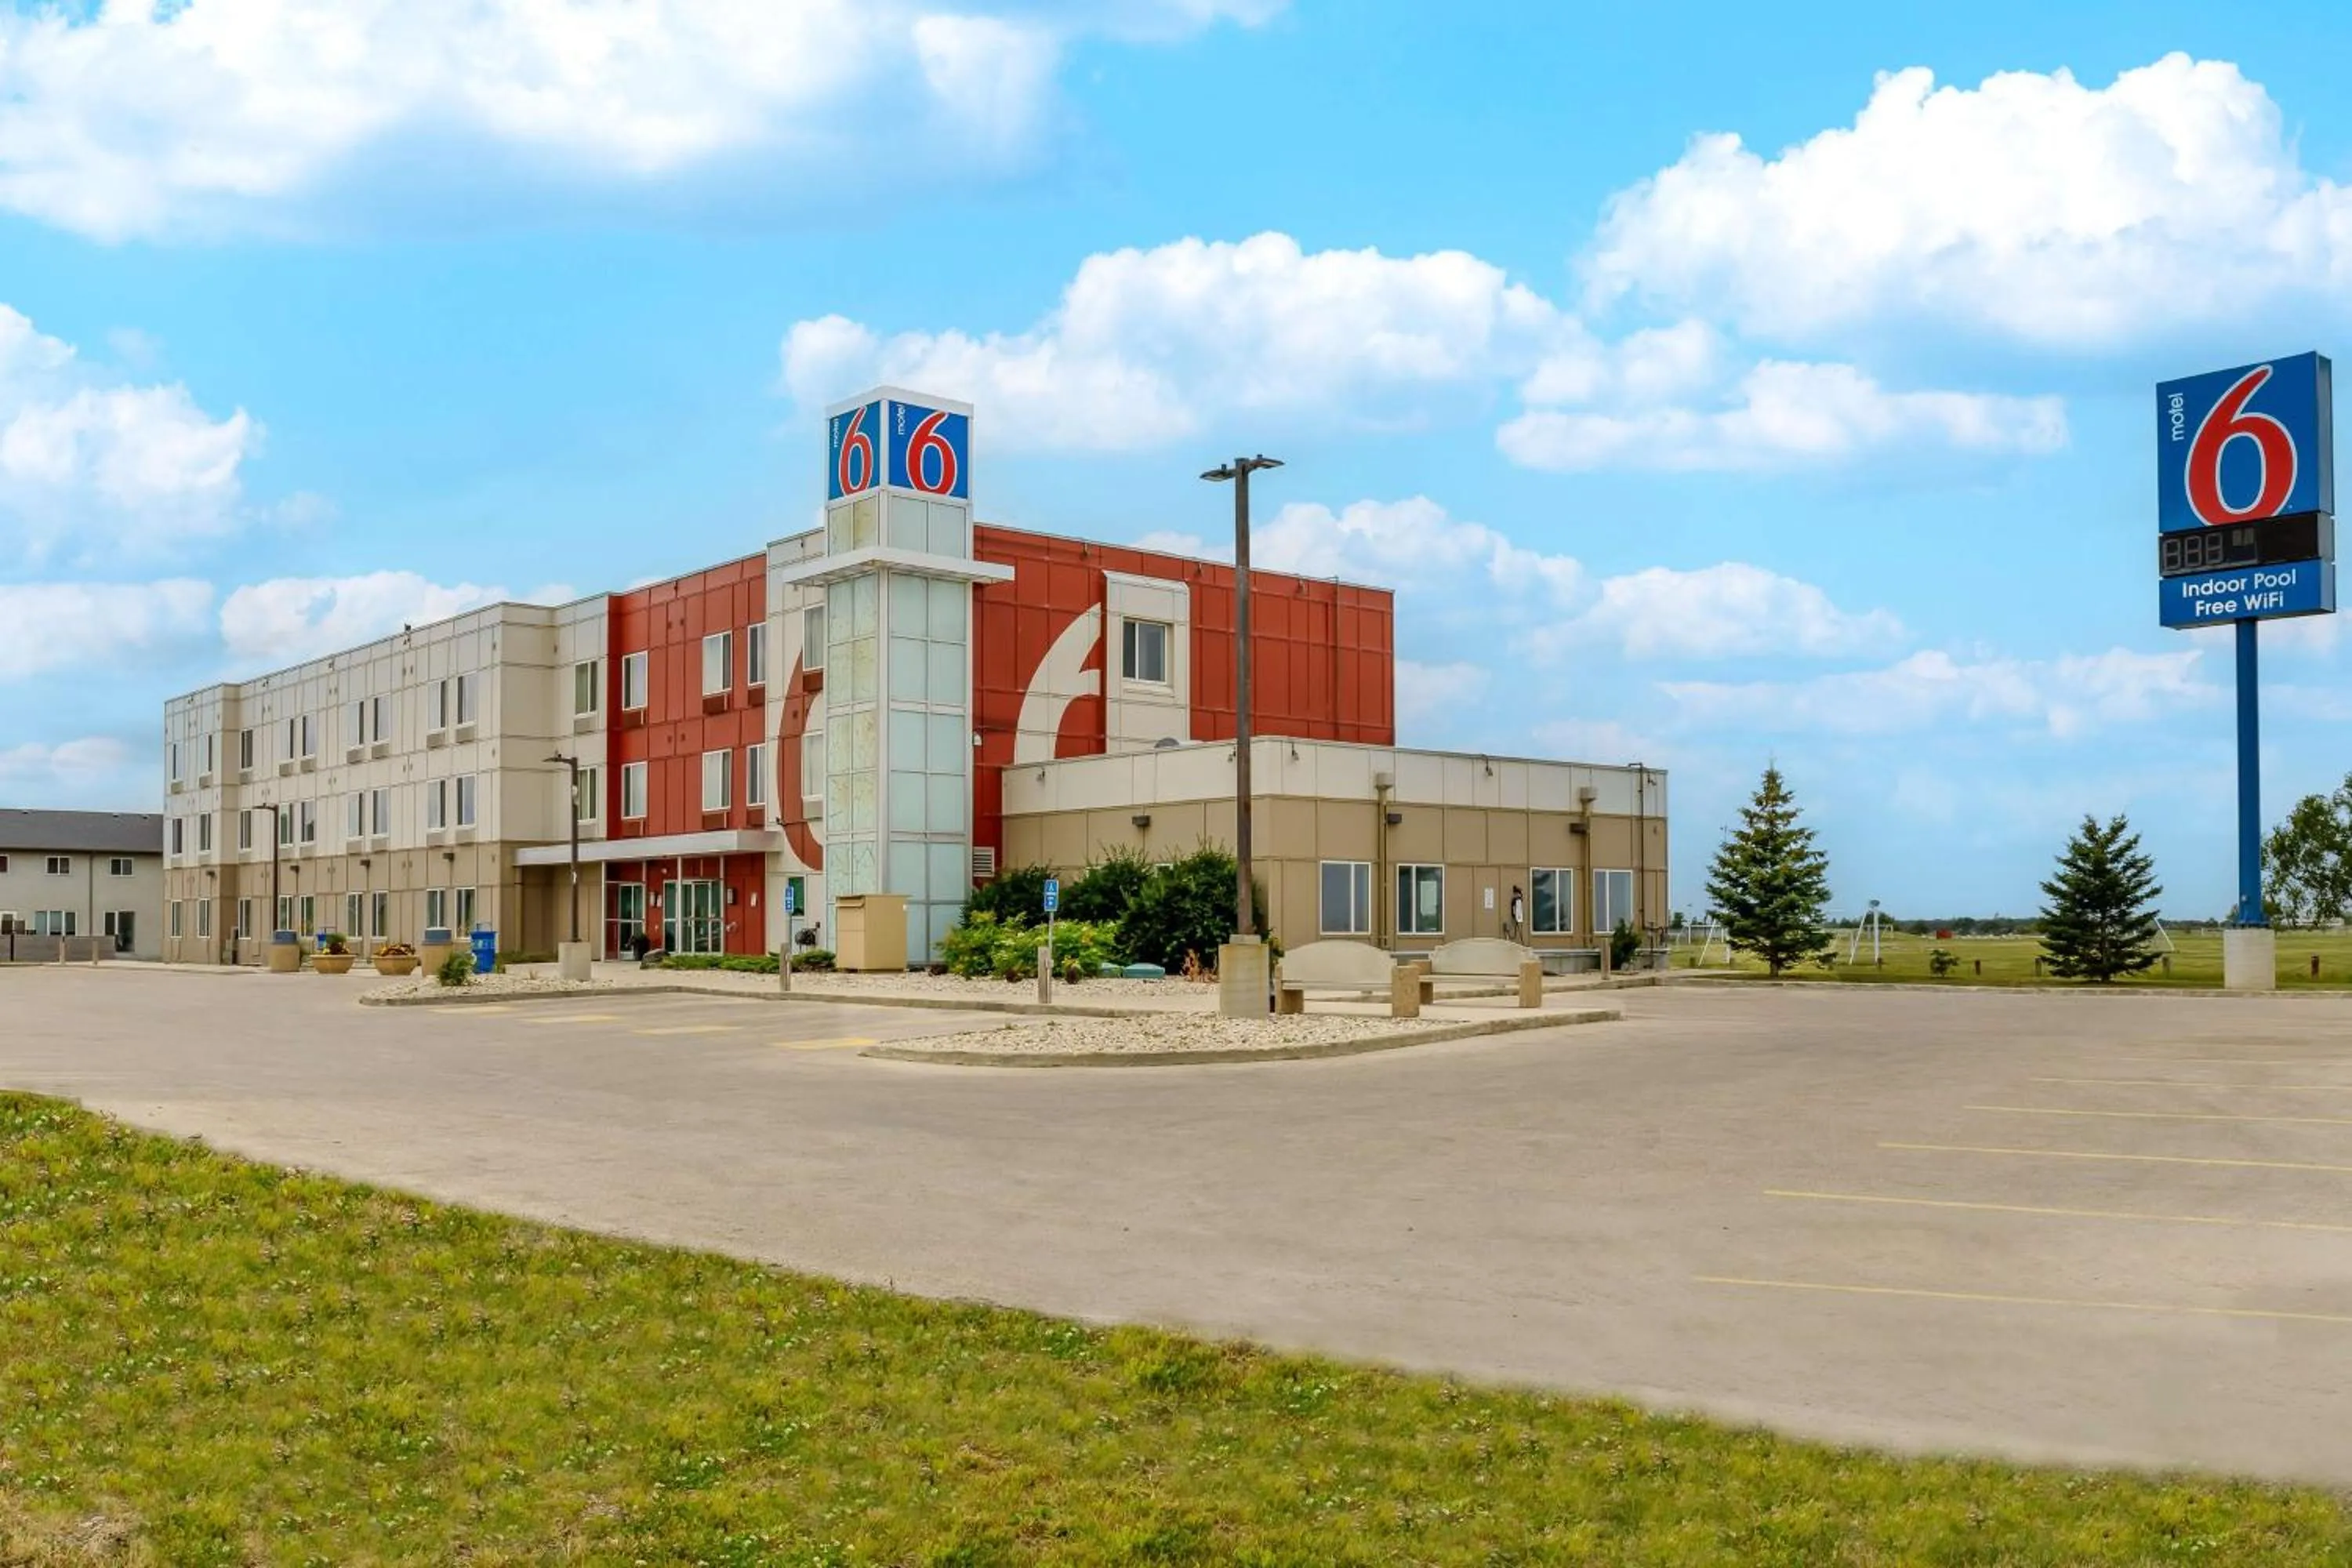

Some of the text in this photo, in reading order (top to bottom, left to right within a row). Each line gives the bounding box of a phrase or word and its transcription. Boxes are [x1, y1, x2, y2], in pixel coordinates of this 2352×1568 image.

[838, 405, 873, 495] 6
[896, 404, 957, 495] motel 6
[2167, 364, 2298, 526] motel 6
[2182, 568, 2296, 598] Indoor Pool
[2195, 591, 2284, 617] Free WiFi
